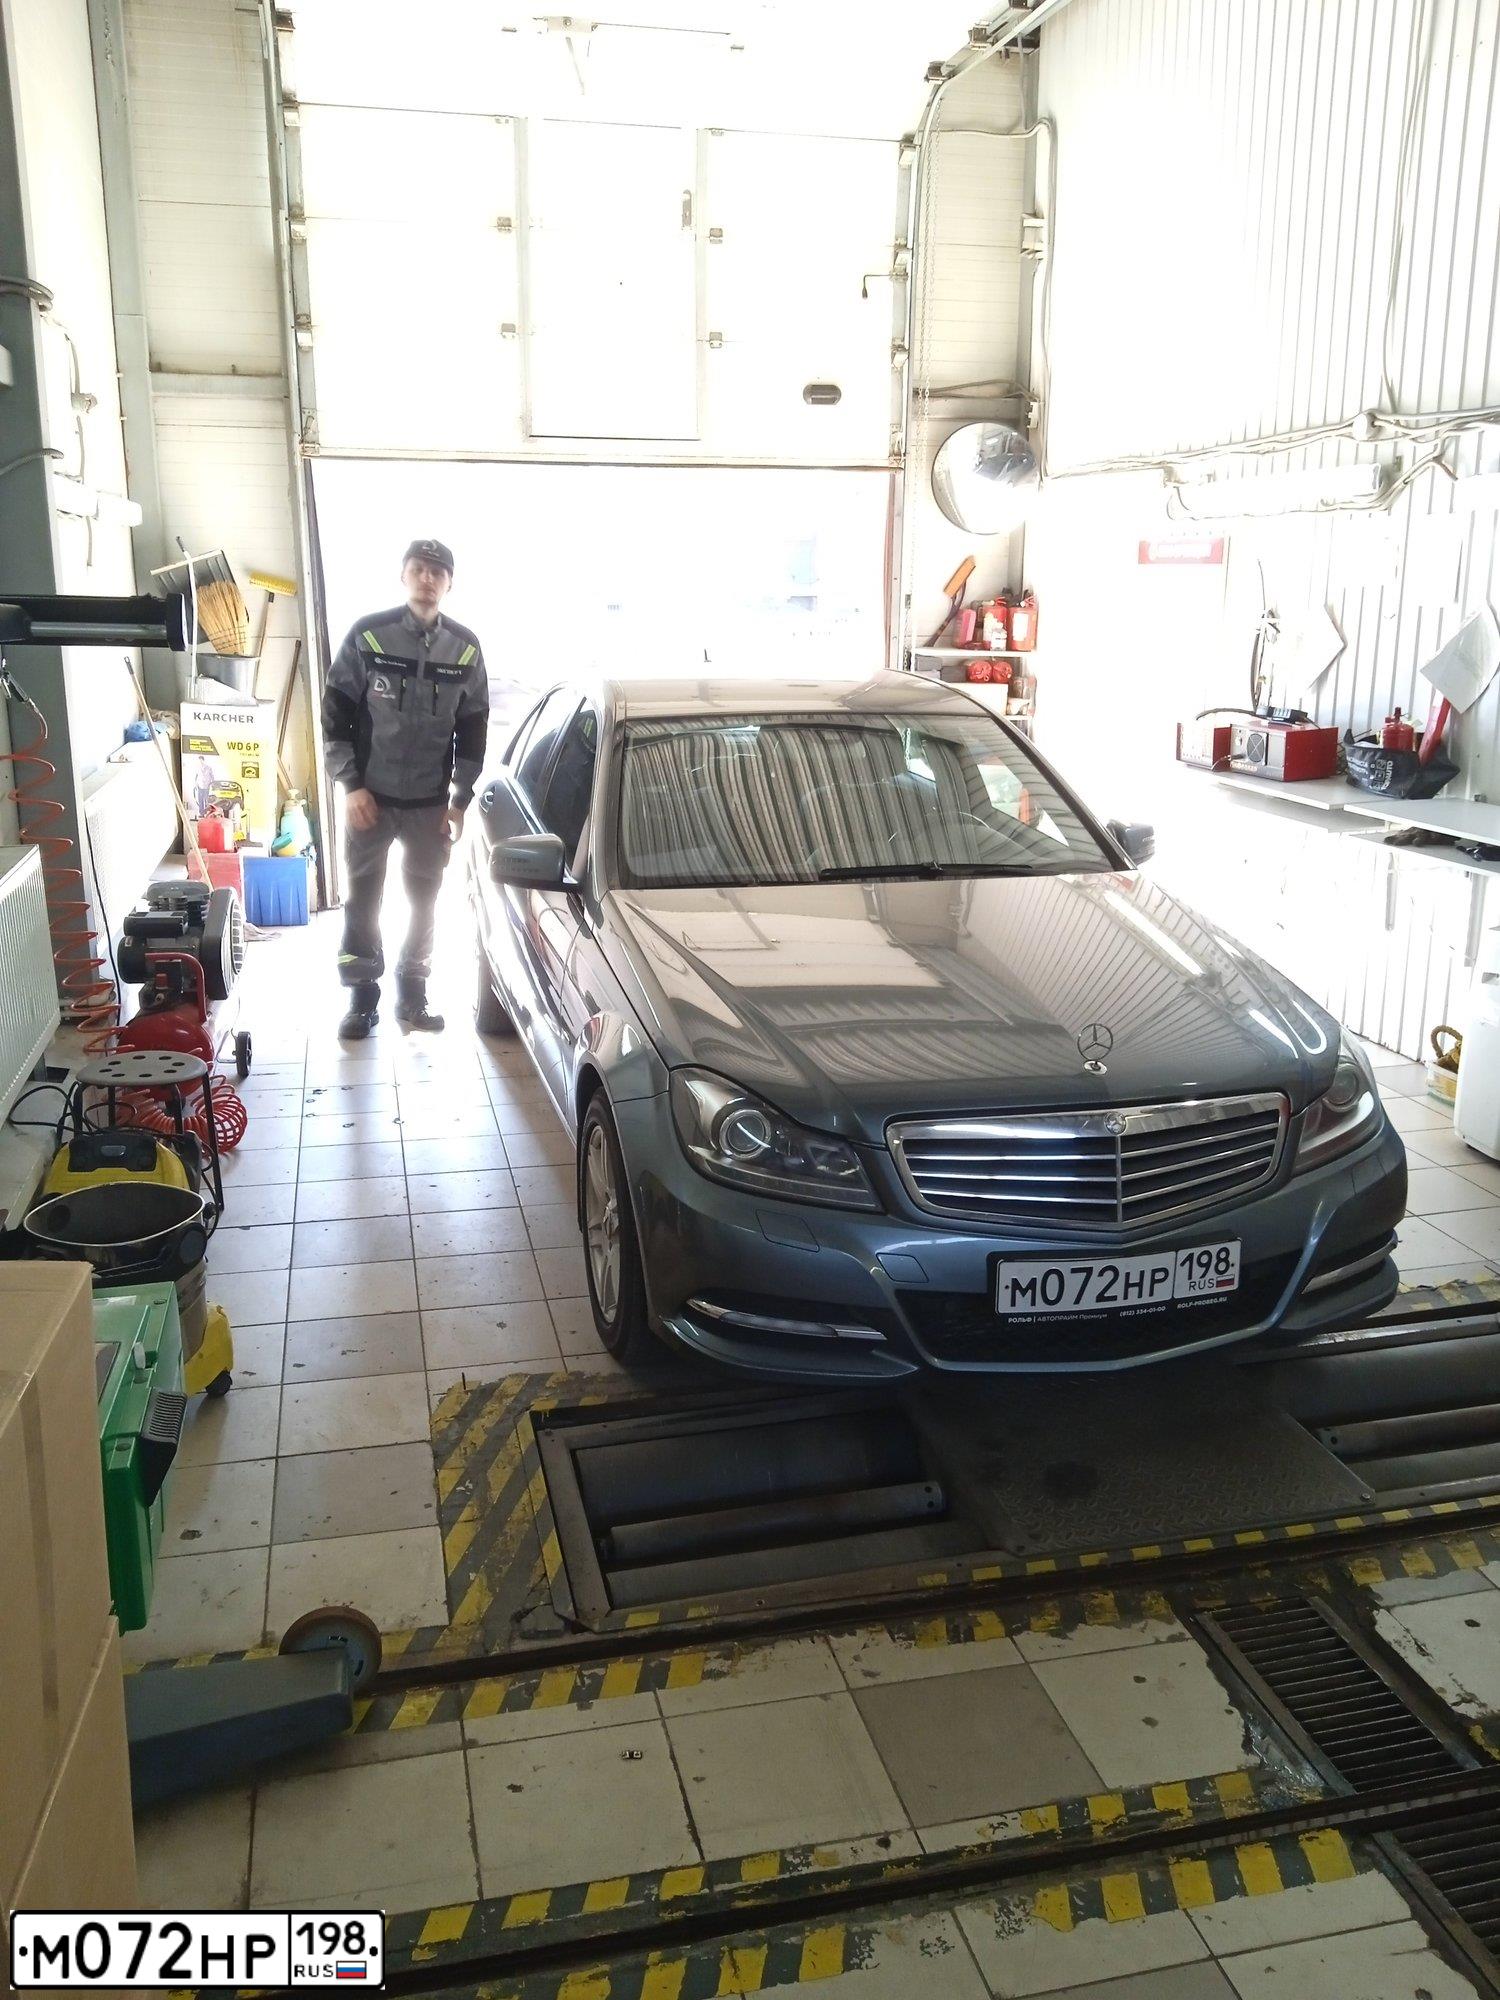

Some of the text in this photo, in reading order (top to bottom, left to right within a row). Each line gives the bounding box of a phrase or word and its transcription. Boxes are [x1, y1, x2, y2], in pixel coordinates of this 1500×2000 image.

[227, 741, 244, 751] WD
[253, 742, 259, 751] P
[1179, 1246, 1231, 1281] 198
[1188, 1277, 1215, 1291] RUS
